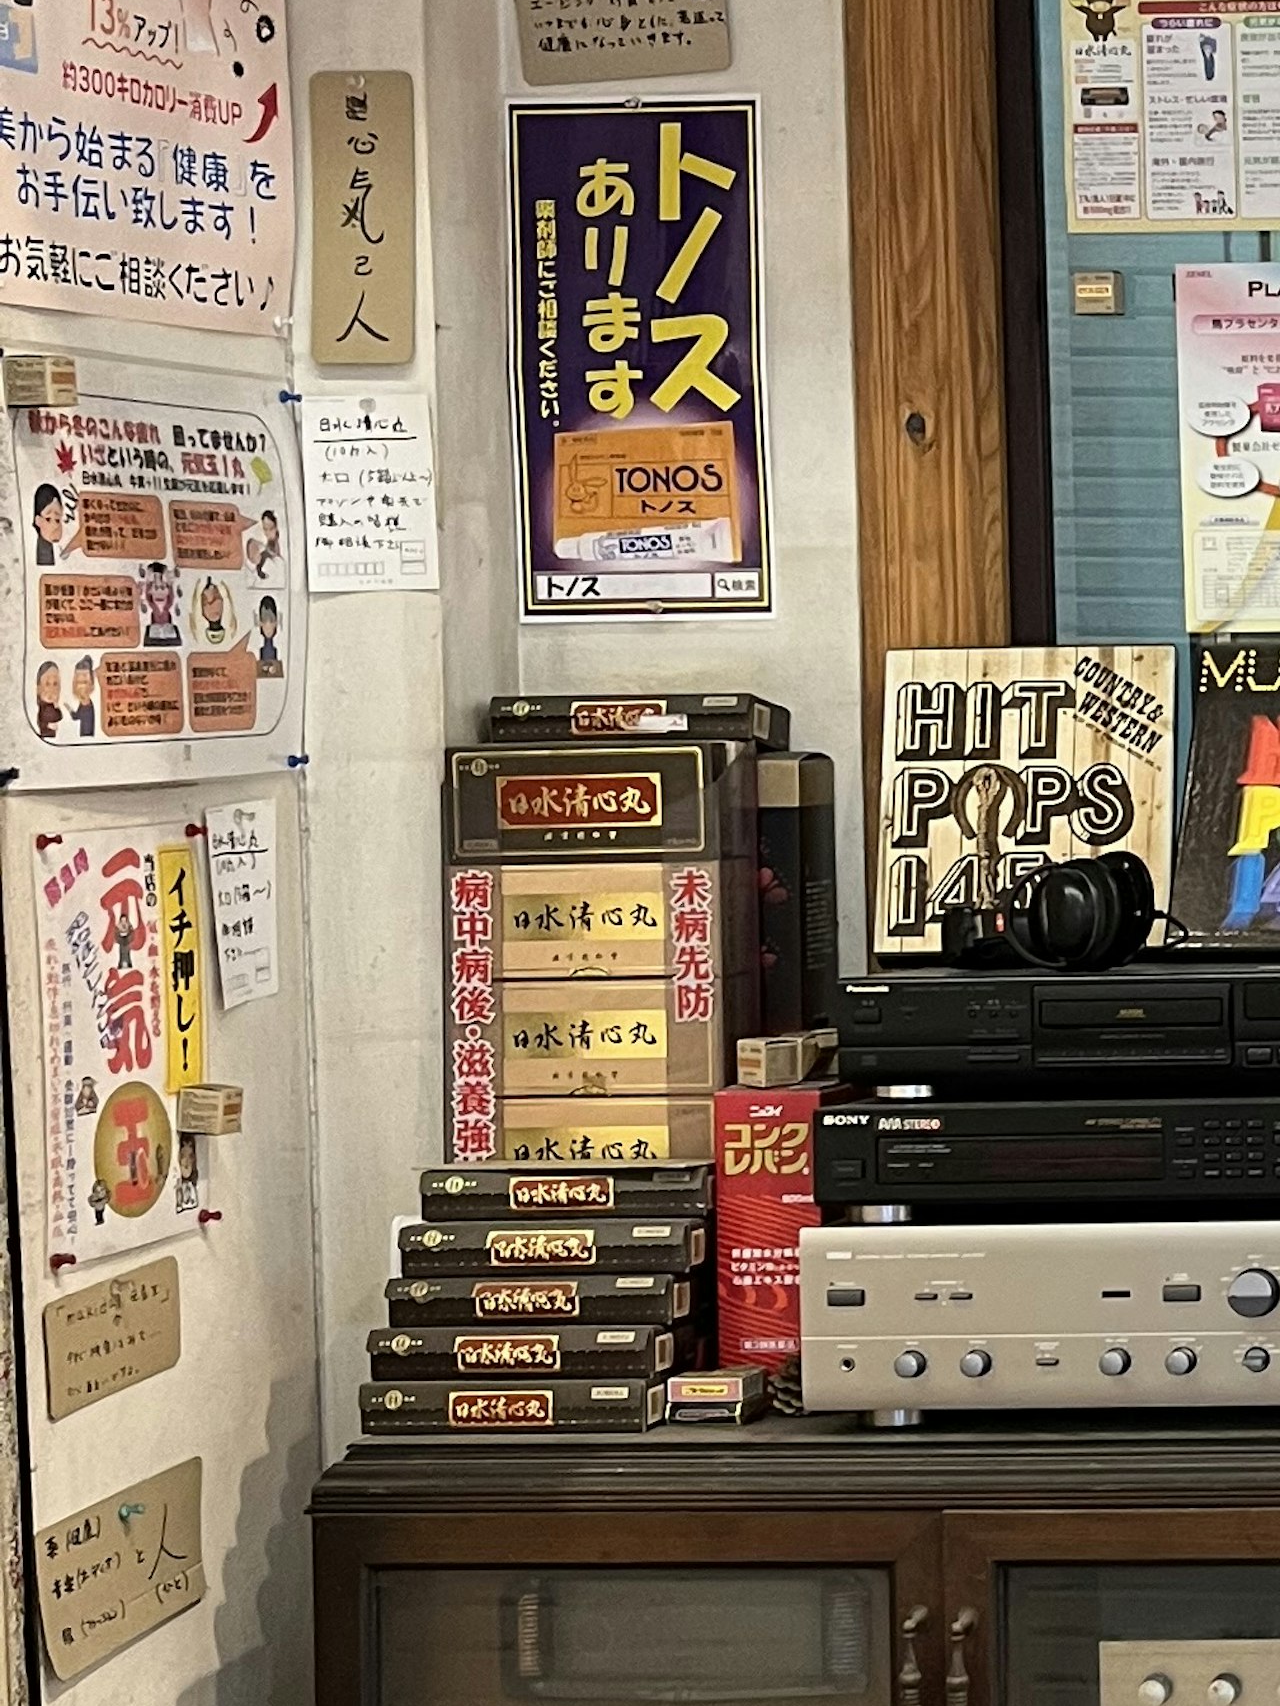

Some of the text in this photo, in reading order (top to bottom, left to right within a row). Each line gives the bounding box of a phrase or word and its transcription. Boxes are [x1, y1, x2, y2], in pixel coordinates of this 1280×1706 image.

[648, 122, 742, 413] トノス
[576, 158, 641, 419] あります
[615, 464, 723, 493] TONOS
[641, 499, 696, 514] トノス
[621, 536, 671, 551] TONOS
[547, 577, 601, 597] トノス
[896, 681, 1067, 761] HIT
[1078, 691, 1163, 754] WESTERN
[508, 783, 652, 820] 日水清心丸
[513, 904, 658, 933] 日水清心丸
[671, 868, 713, 1022] 未病先防
[450, 869, 494, 1162] 病中病後・滋養強
[513, 1021, 658, 1051] 日水清心丸
[823, 1114, 870, 1126] SONY
[723, 1123, 809, 1149] コンク
[723, 1150, 806, 1176] レバン
[514, 1184, 608, 1206] 日水清心丸
[493, 1237, 592, 1261] 日水清心丸
[479, 1287, 573, 1315] 日水清心丸
[461, 1342, 554, 1367] 日水清心丸
[455, 1394, 547, 1418] 日水清心丸
